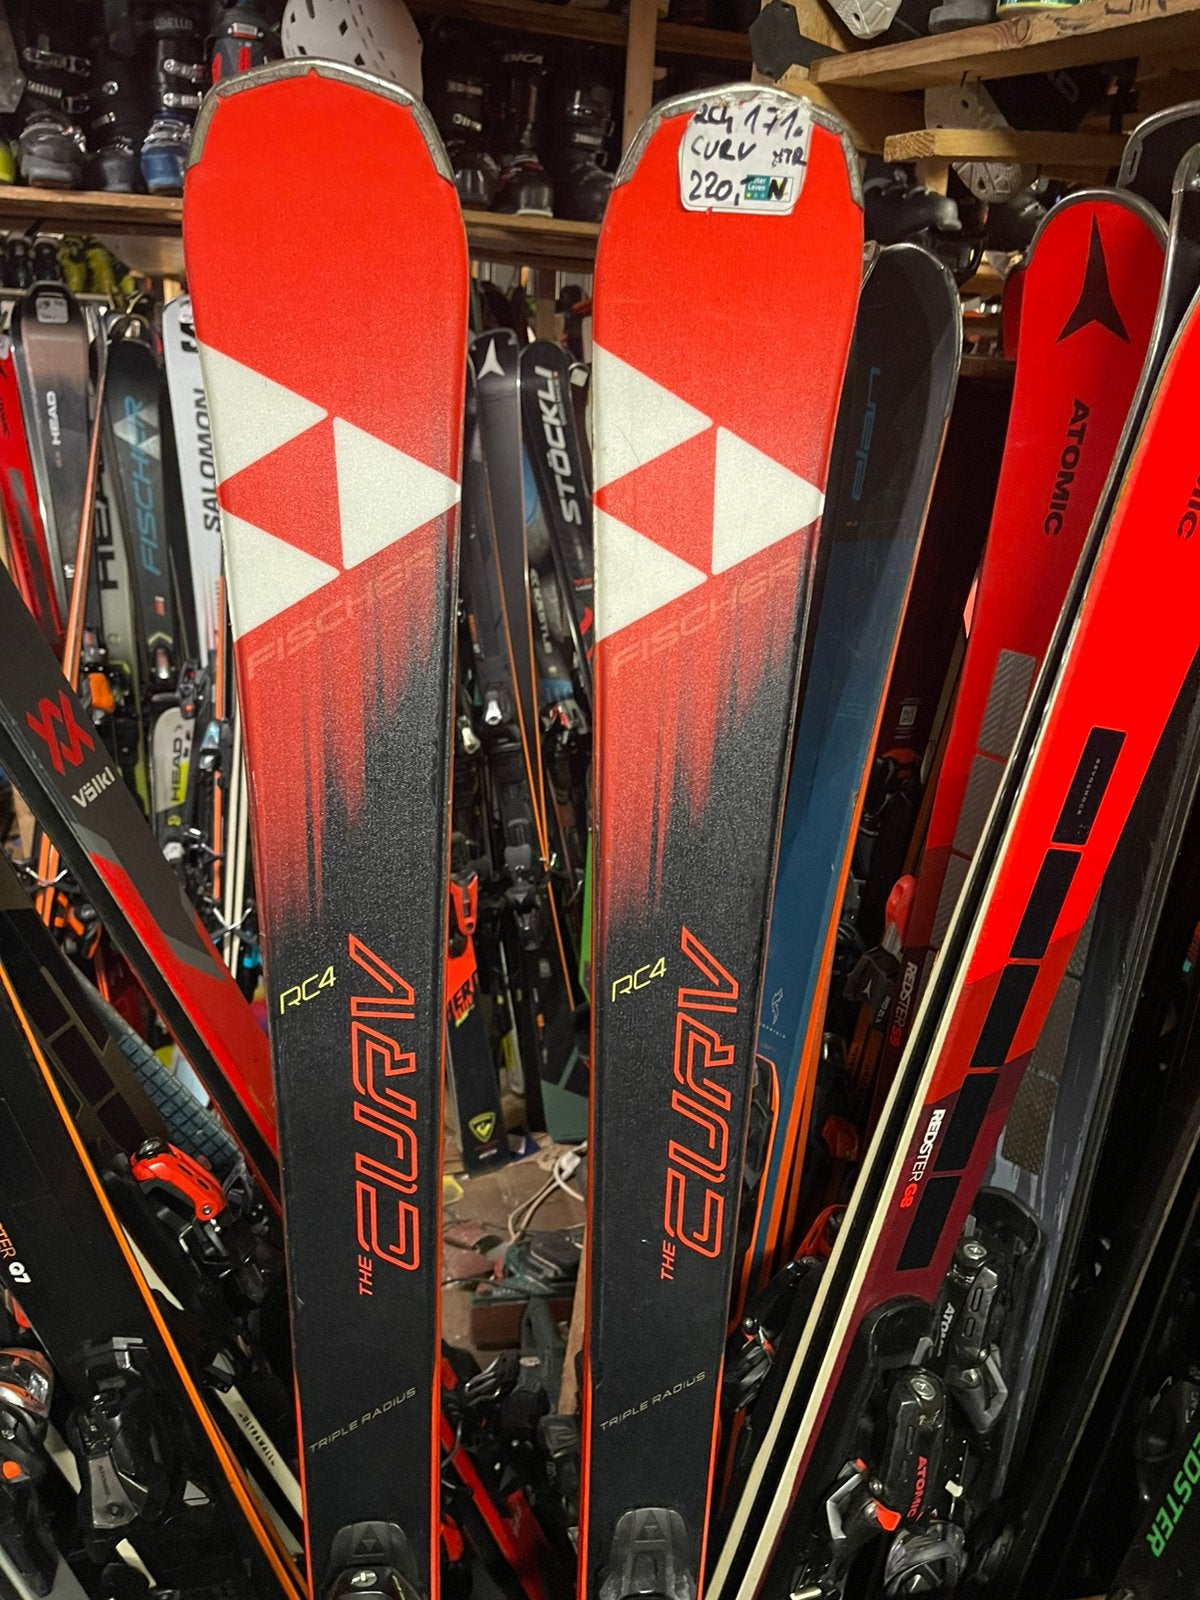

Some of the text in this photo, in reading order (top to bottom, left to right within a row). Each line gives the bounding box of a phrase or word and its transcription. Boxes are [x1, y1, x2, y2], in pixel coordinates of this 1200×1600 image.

[691, 135, 757, 161] CURV
[46, 391, 61, 446] HEAD
[534, 365, 583, 525] STÖCKLI
[194, 388, 223, 533] SALOMON
[1044, 398, 1090, 536] ATOMIC
[71, 766, 115, 808] Völkl
[171, 738, 183, 801] HEAD
[280, 965, 336, 1015] RC4
[611, 956, 667, 1002] RC4
[348, 932, 420, 1297] THE CURV
[660, 925, 739, 1281] THE CURV
[908, 1109, 947, 1182] REDSTER
[8, 1261, 32, 1283] Q7
[308, 1387, 417, 1453] TRIPLE RADIUS
[599, 1371, 706, 1431] TRIPLE RADIUS
[906, 1455, 928, 1519] ATOMIC
